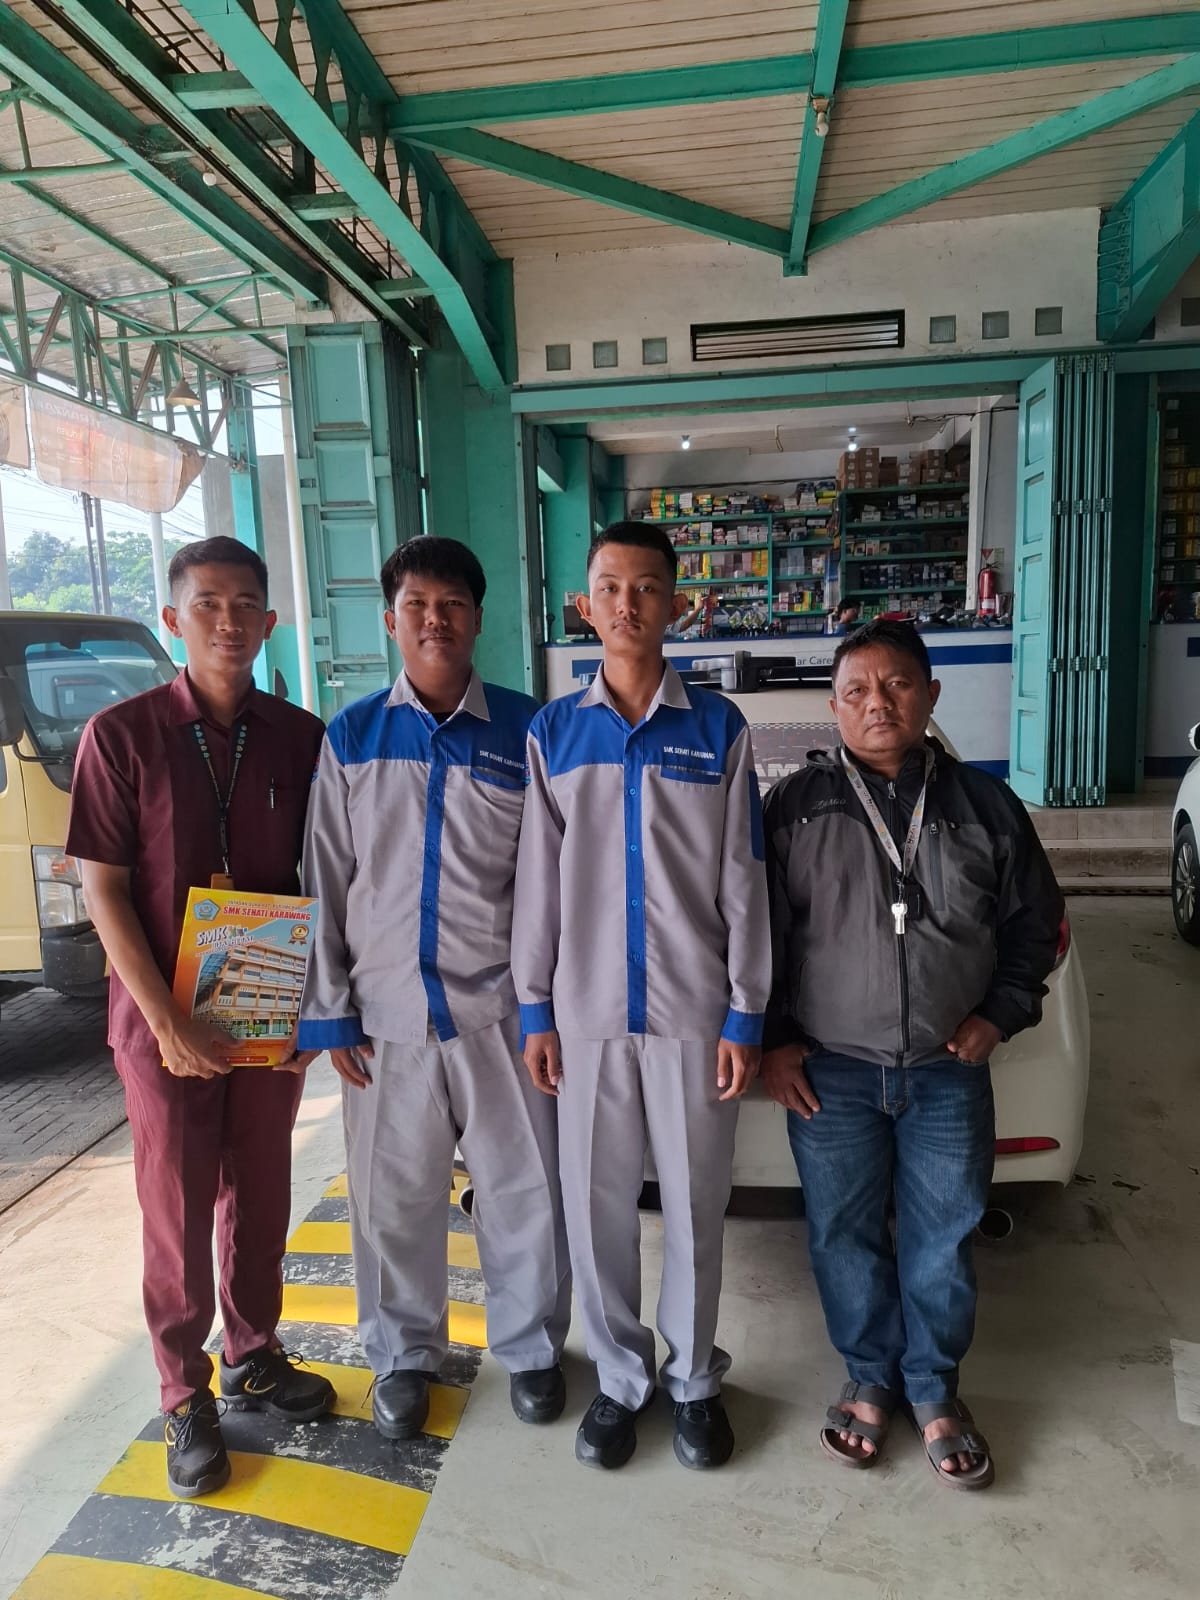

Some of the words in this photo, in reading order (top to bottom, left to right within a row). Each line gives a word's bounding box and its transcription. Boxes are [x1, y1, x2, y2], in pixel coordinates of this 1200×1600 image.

[223, 906, 241, 916] SMK
[241, 907, 268, 918] SEHATI
[269, 910, 312, 921] KARAWANG
